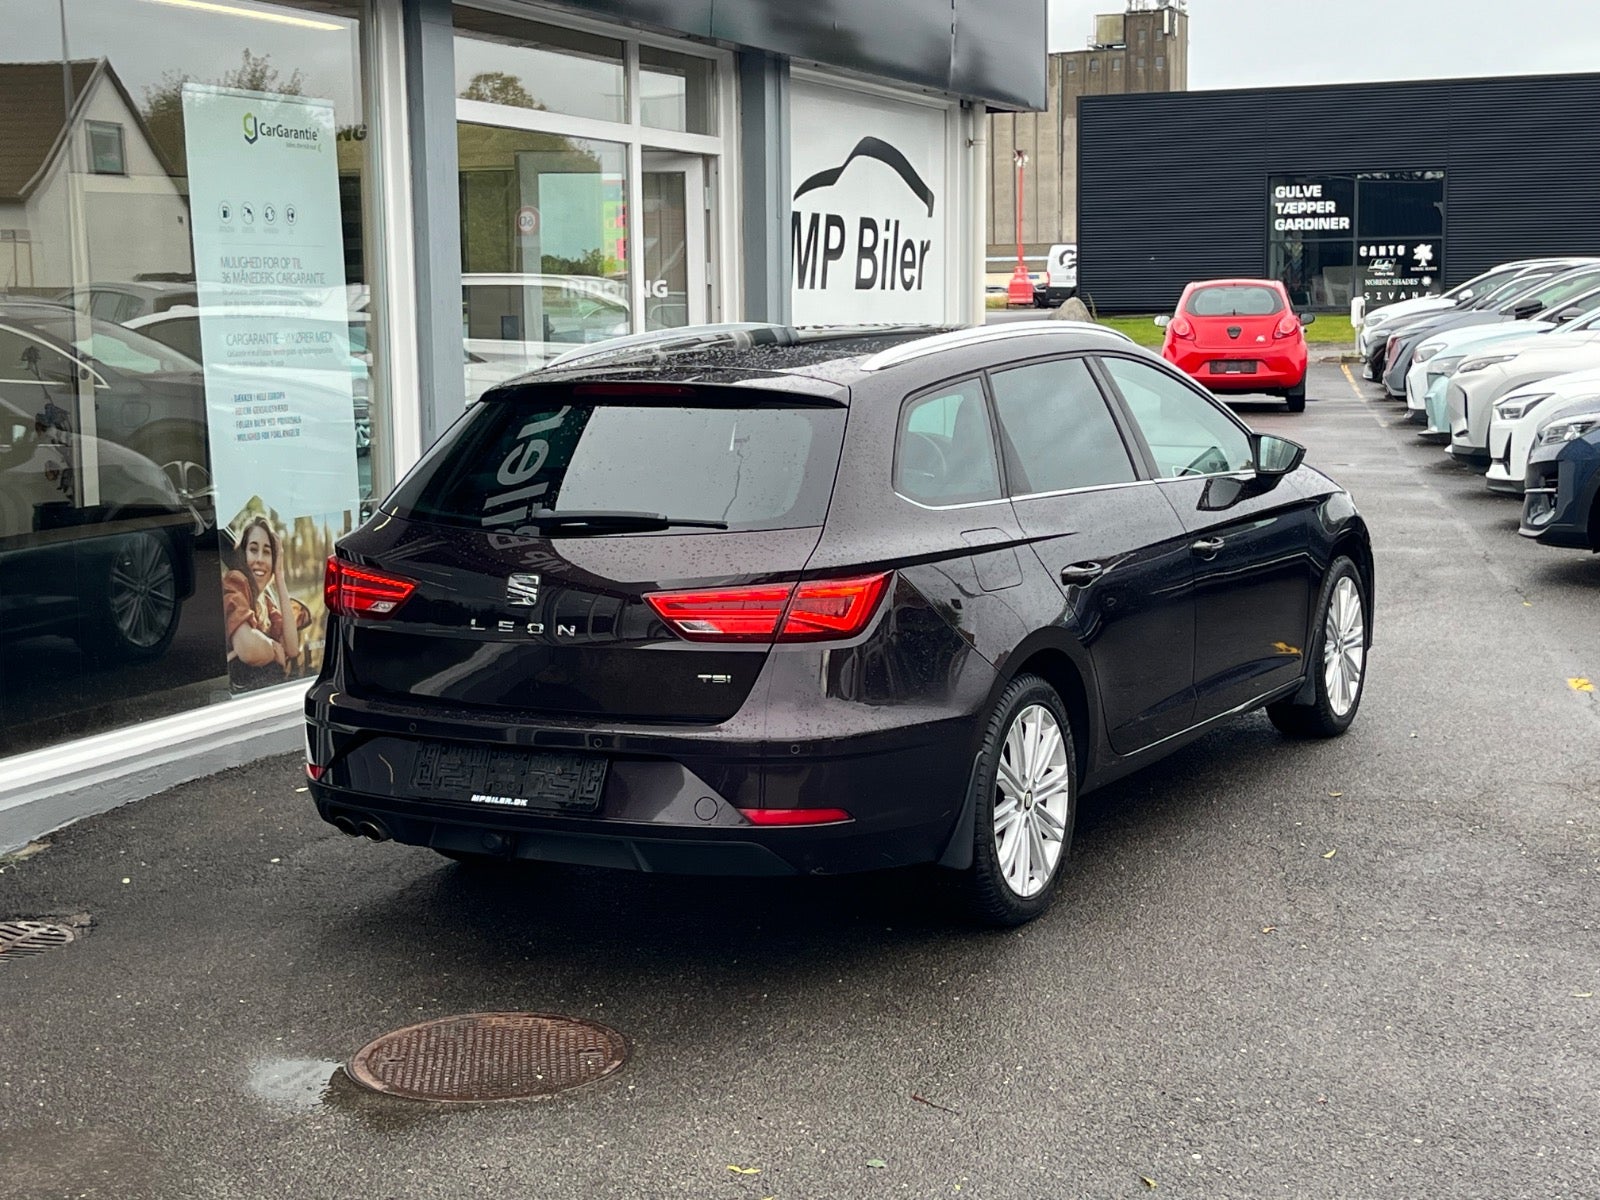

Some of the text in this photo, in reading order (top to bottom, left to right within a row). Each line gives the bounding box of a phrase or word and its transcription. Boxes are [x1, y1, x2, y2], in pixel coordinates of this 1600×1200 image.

[259, 121, 318, 141] CarGarantie
[1274, 185, 1322, 198] GULVE
[1275, 201, 1336, 215] TÆPPER
[1274, 217, 1350, 231] GARDINER
[792, 211, 931, 291] MP Biler
[470, 618, 576, 637] LEON
